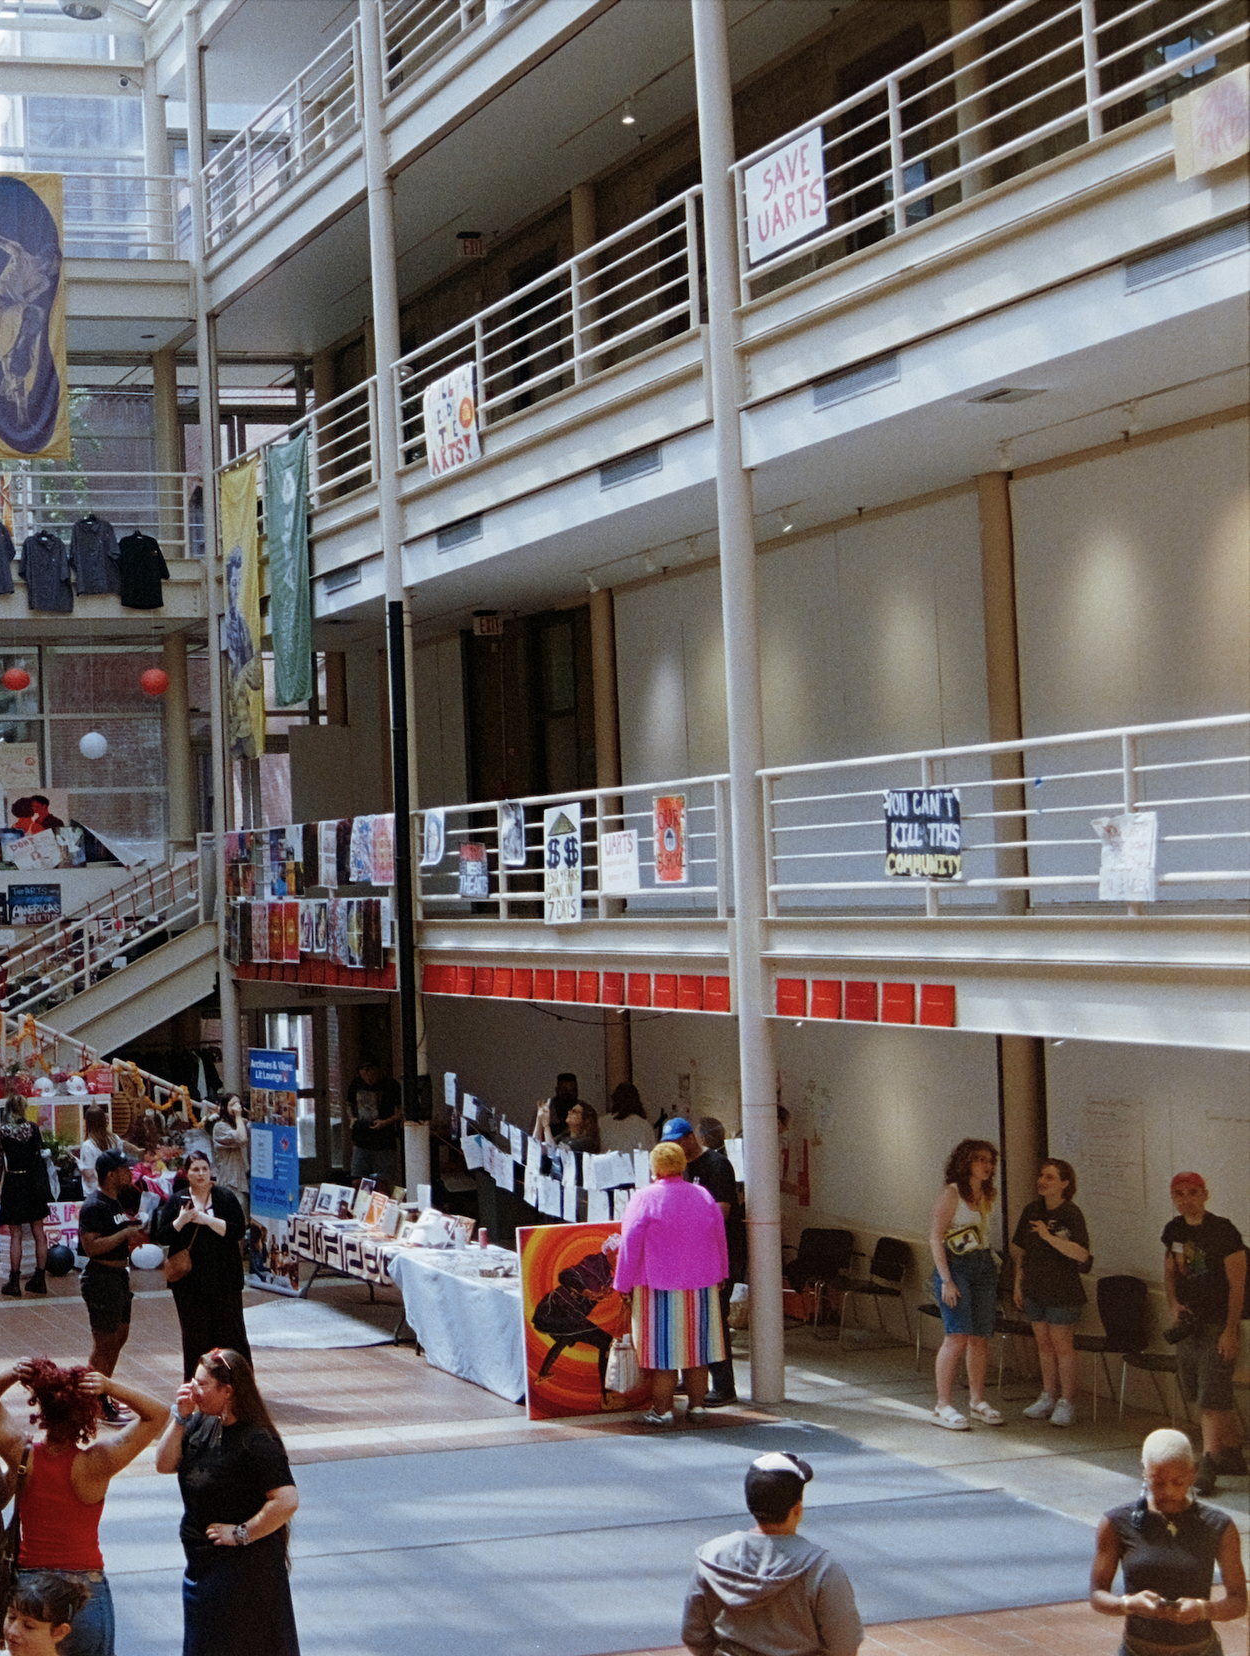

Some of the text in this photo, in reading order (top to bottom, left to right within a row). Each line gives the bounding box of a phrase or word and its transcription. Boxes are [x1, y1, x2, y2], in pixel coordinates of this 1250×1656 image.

[763, 143, 810, 202] SAVE
[757, 177, 823, 242] UARTS
[886, 792, 953, 817] YOU CAN'T
[891, 822, 961, 849] KILL THIS
[885, 853, 961, 875] COMMUNITY
[251, 1059, 272, 1069] Archives
